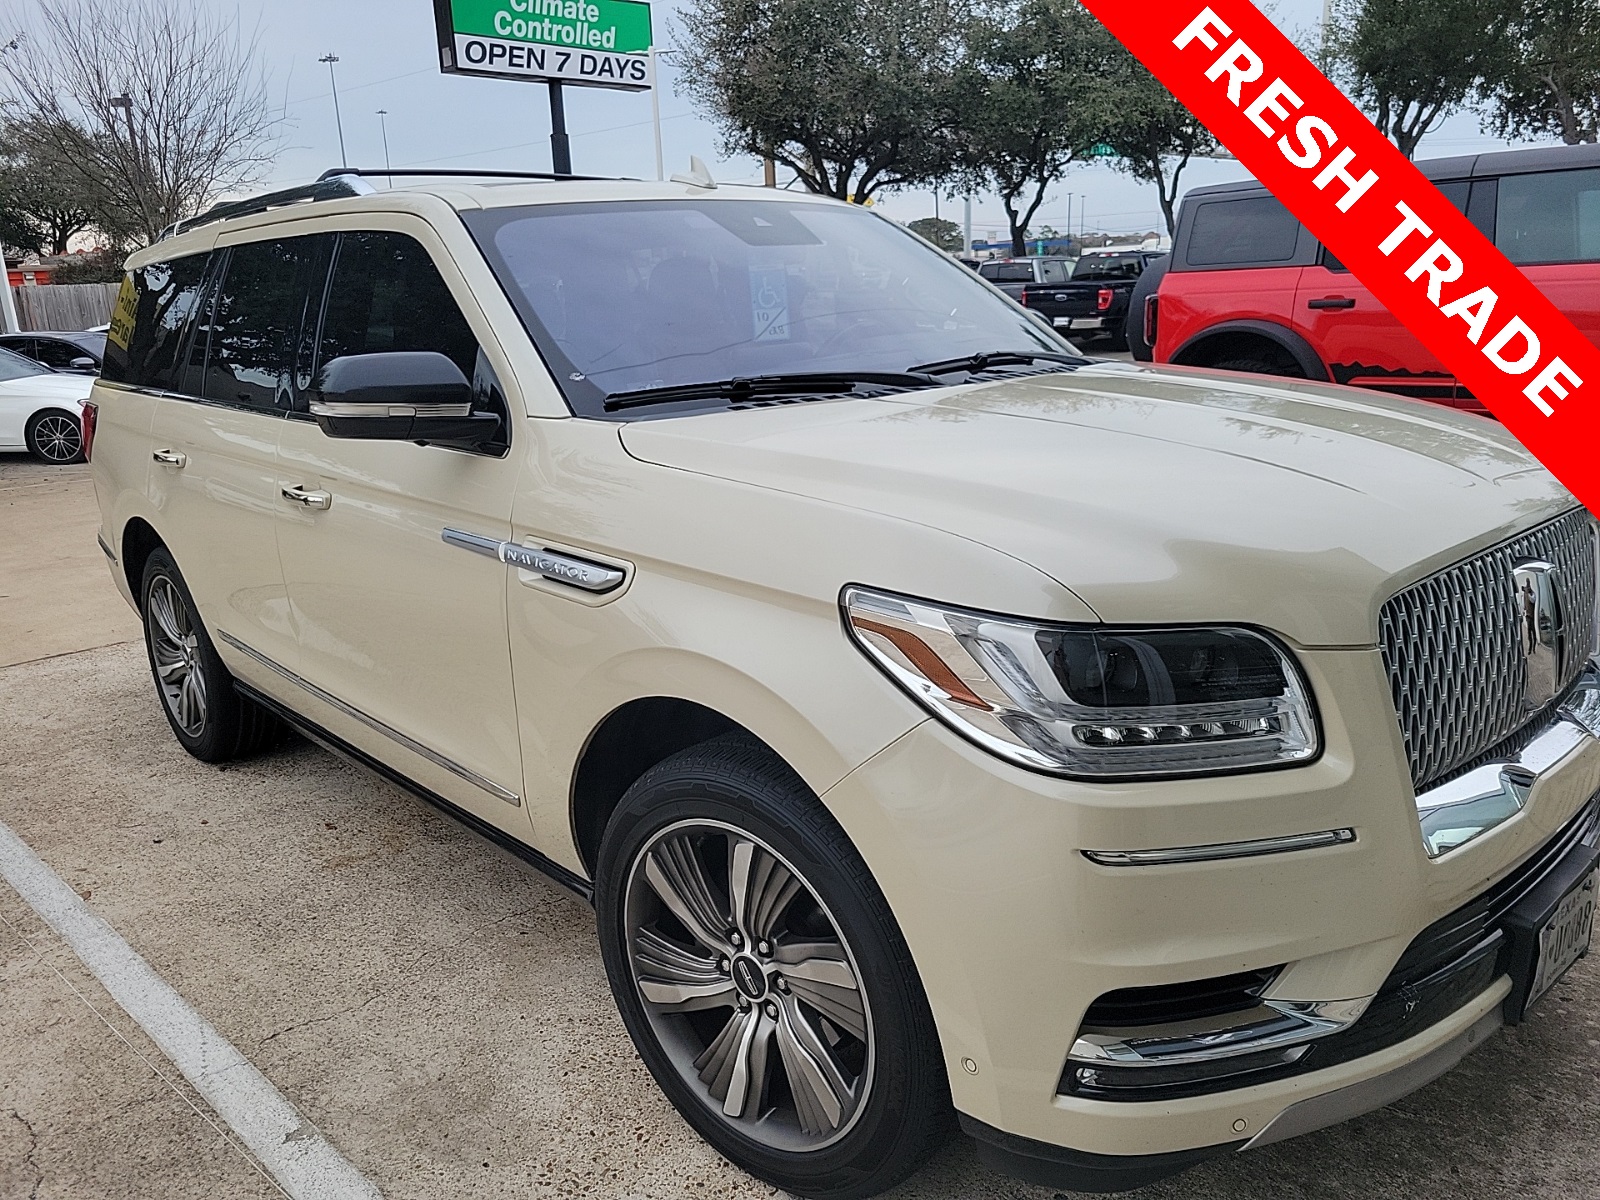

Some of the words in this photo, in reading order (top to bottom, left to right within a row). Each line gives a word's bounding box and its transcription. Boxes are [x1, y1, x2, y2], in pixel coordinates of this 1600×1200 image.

[510, 0, 600, 22] Climate
[494, 10, 616, 49] Controlled
[465, 41, 546, 70] OPEN
[555, 52, 572, 73] 7
[580, 54, 647, 81] DAYS
[507, 549, 589, 582] NAVIGATOR
